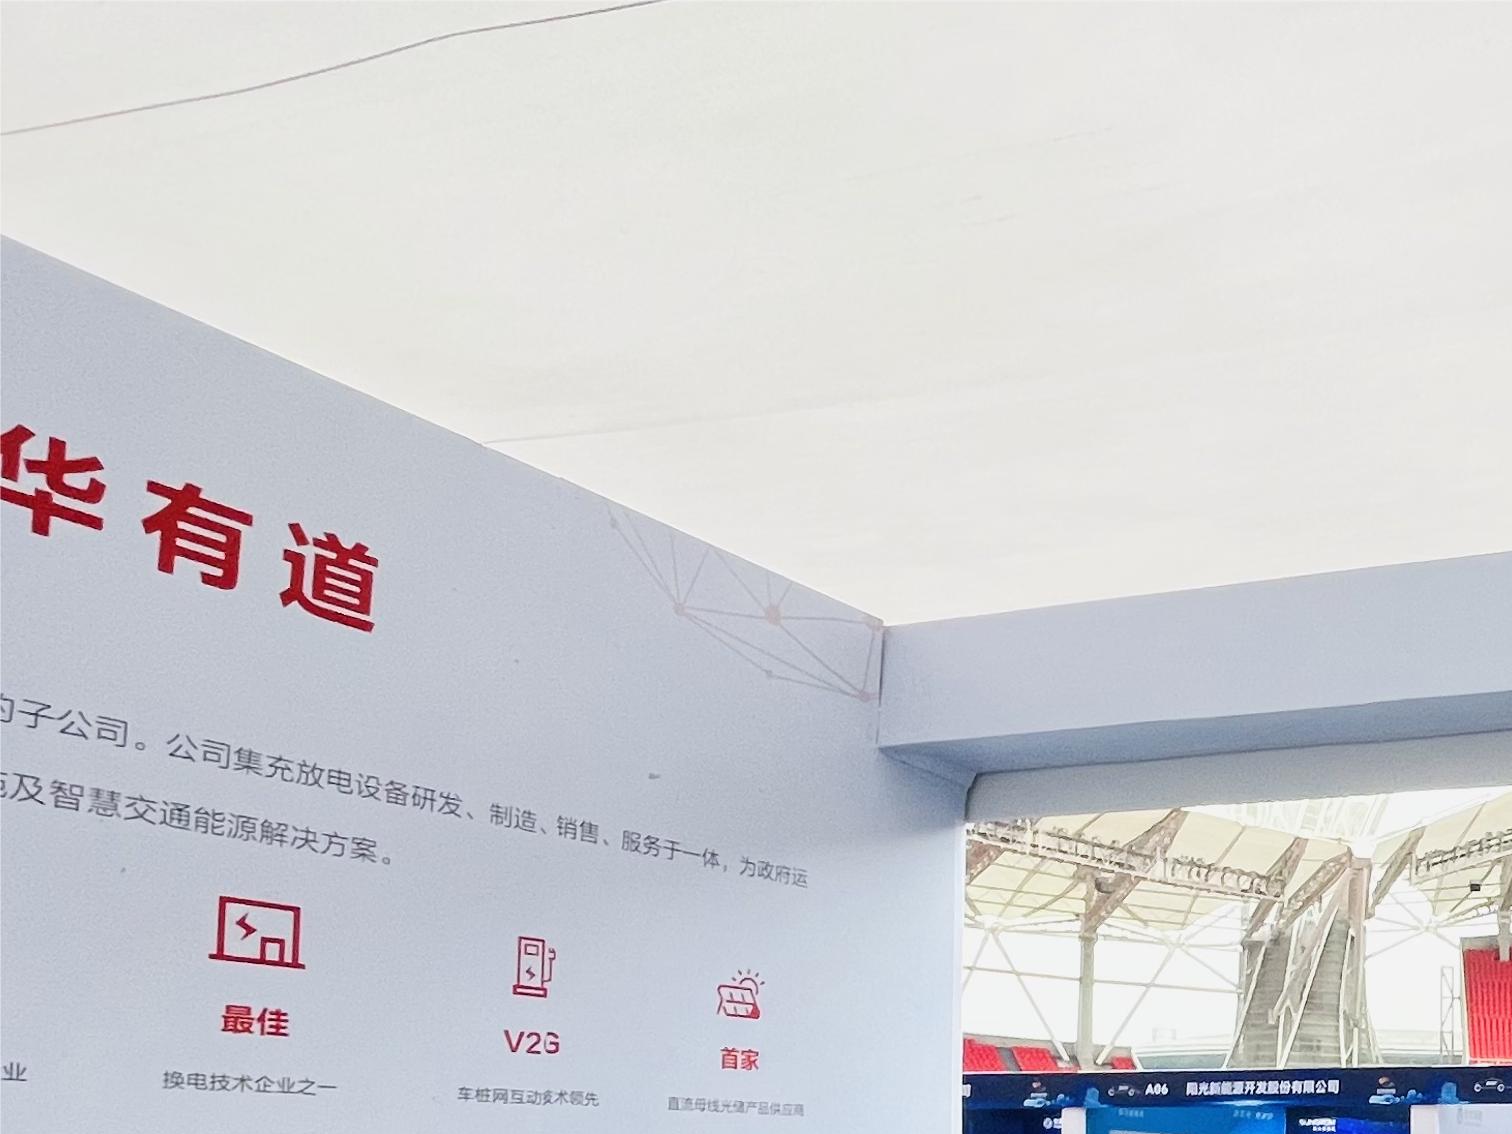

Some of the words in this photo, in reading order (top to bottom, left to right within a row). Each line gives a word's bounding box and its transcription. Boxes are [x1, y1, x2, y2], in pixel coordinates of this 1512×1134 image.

[221, 1004, 290, 1038] 最佳
[503, 1029, 561, 1055] V2G
[720, 1047, 760, 1071] 首家
[162, 1070, 339, 1096] 换电技术企业之一
[1144, 1083, 1170, 1096] A06
[1185, 1079, 1341, 1097] 阳光新能源开发股份有限公司
